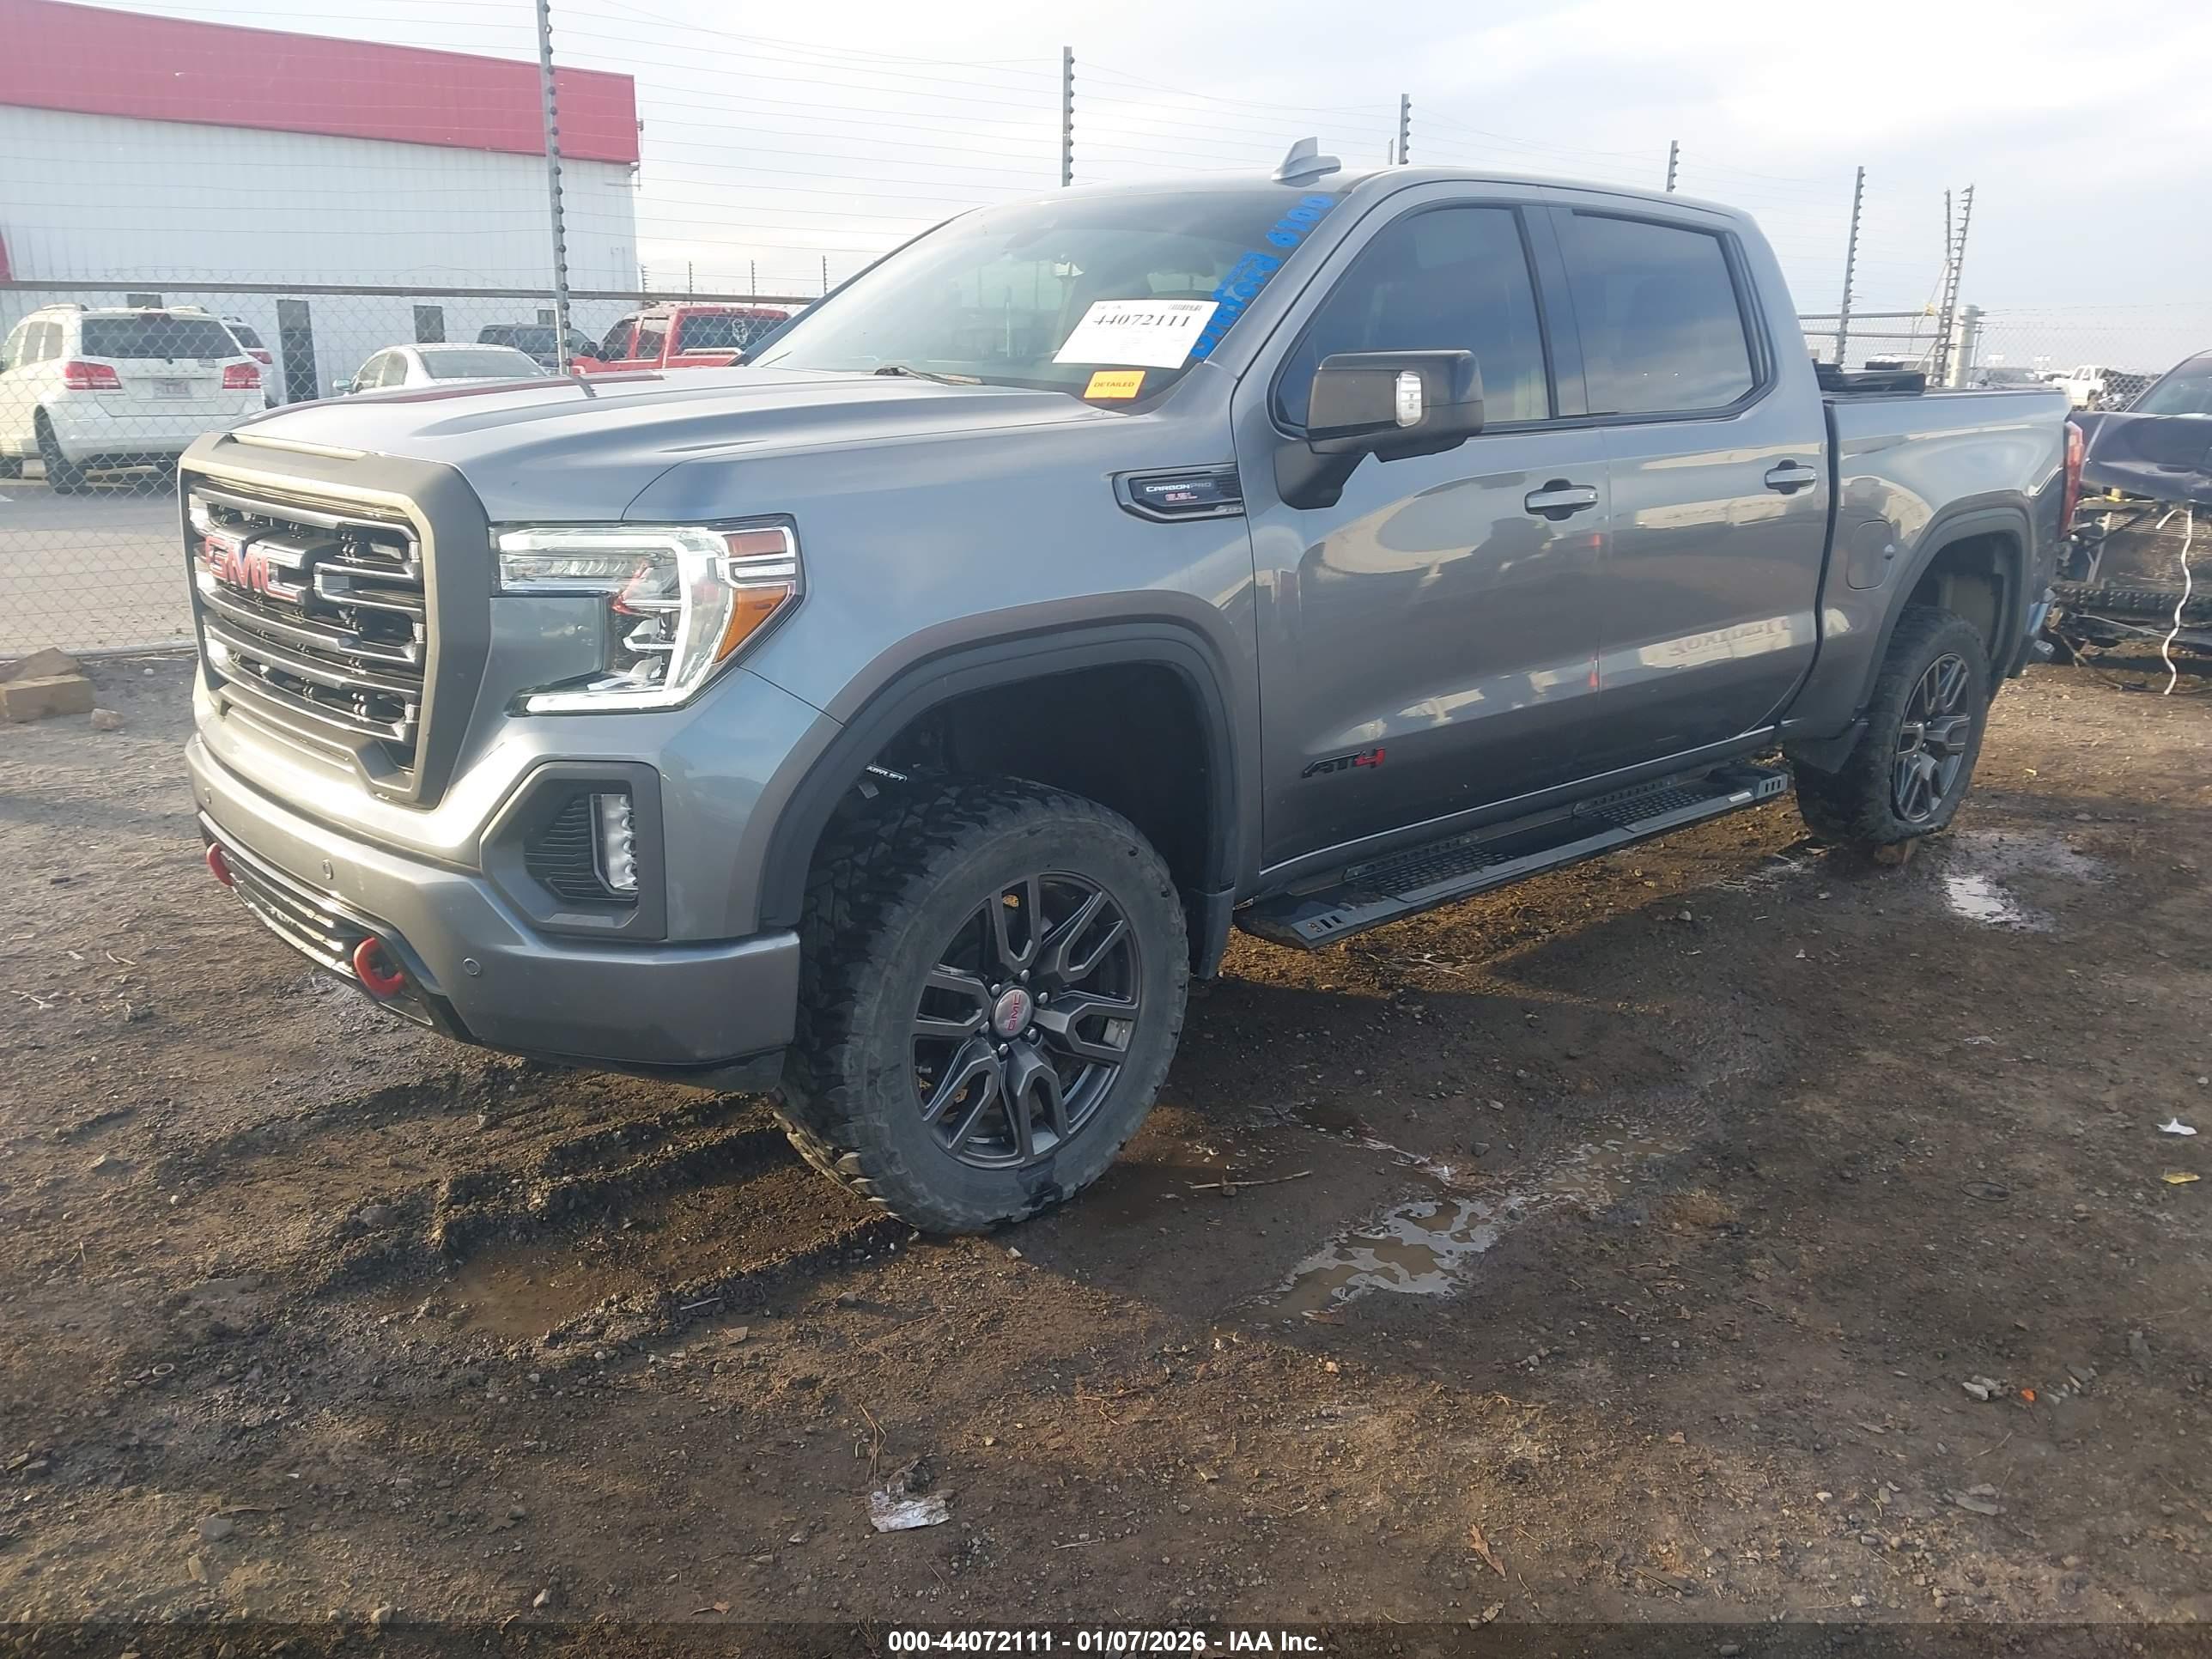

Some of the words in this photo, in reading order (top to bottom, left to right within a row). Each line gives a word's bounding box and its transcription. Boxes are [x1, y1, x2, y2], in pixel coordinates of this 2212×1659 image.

[1092, 313, 1191, 327] 44072111
[204, 534, 307, 603] GMC
[1300, 746, 1387, 780] AT4
[1007, 993, 1022, 1031] GMC
